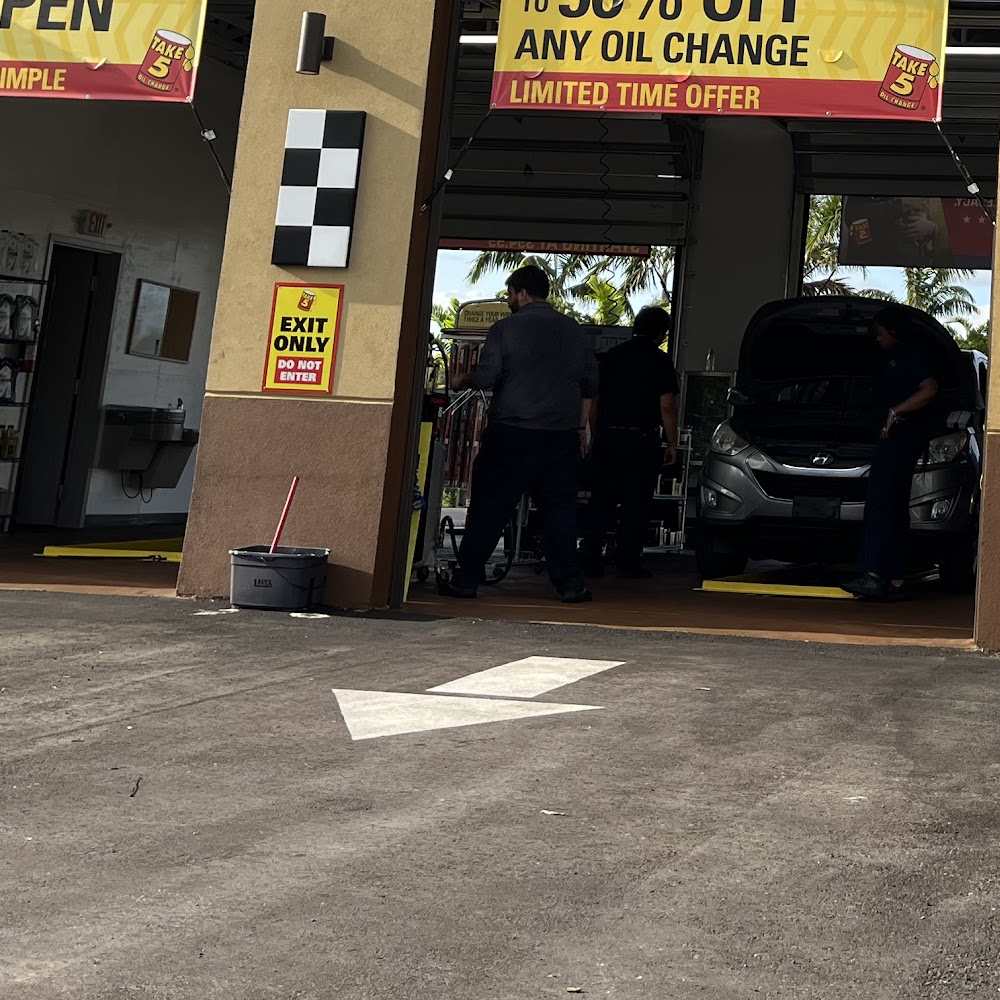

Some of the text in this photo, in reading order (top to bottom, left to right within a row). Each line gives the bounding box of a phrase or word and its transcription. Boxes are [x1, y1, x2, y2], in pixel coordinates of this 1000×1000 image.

[151, 36, 184, 60] TAKE
[514, 29, 810, 67] ANY OIL CHANGE
[147, 55, 172, 79] 5
[892, 51, 929, 77] TAKE
[0, 67, 67, 91] IMPLE
[889, 71, 916, 97] 5
[510, 78, 760, 110] LIMITED TIME OFFER
[88, 211, 107, 236] EXIT
[280, 316, 328, 333] EXIT
[273, 335, 331, 352] ONLY
[278, 359, 322, 370] DO NOT
[279, 371, 317, 382] ENTER
